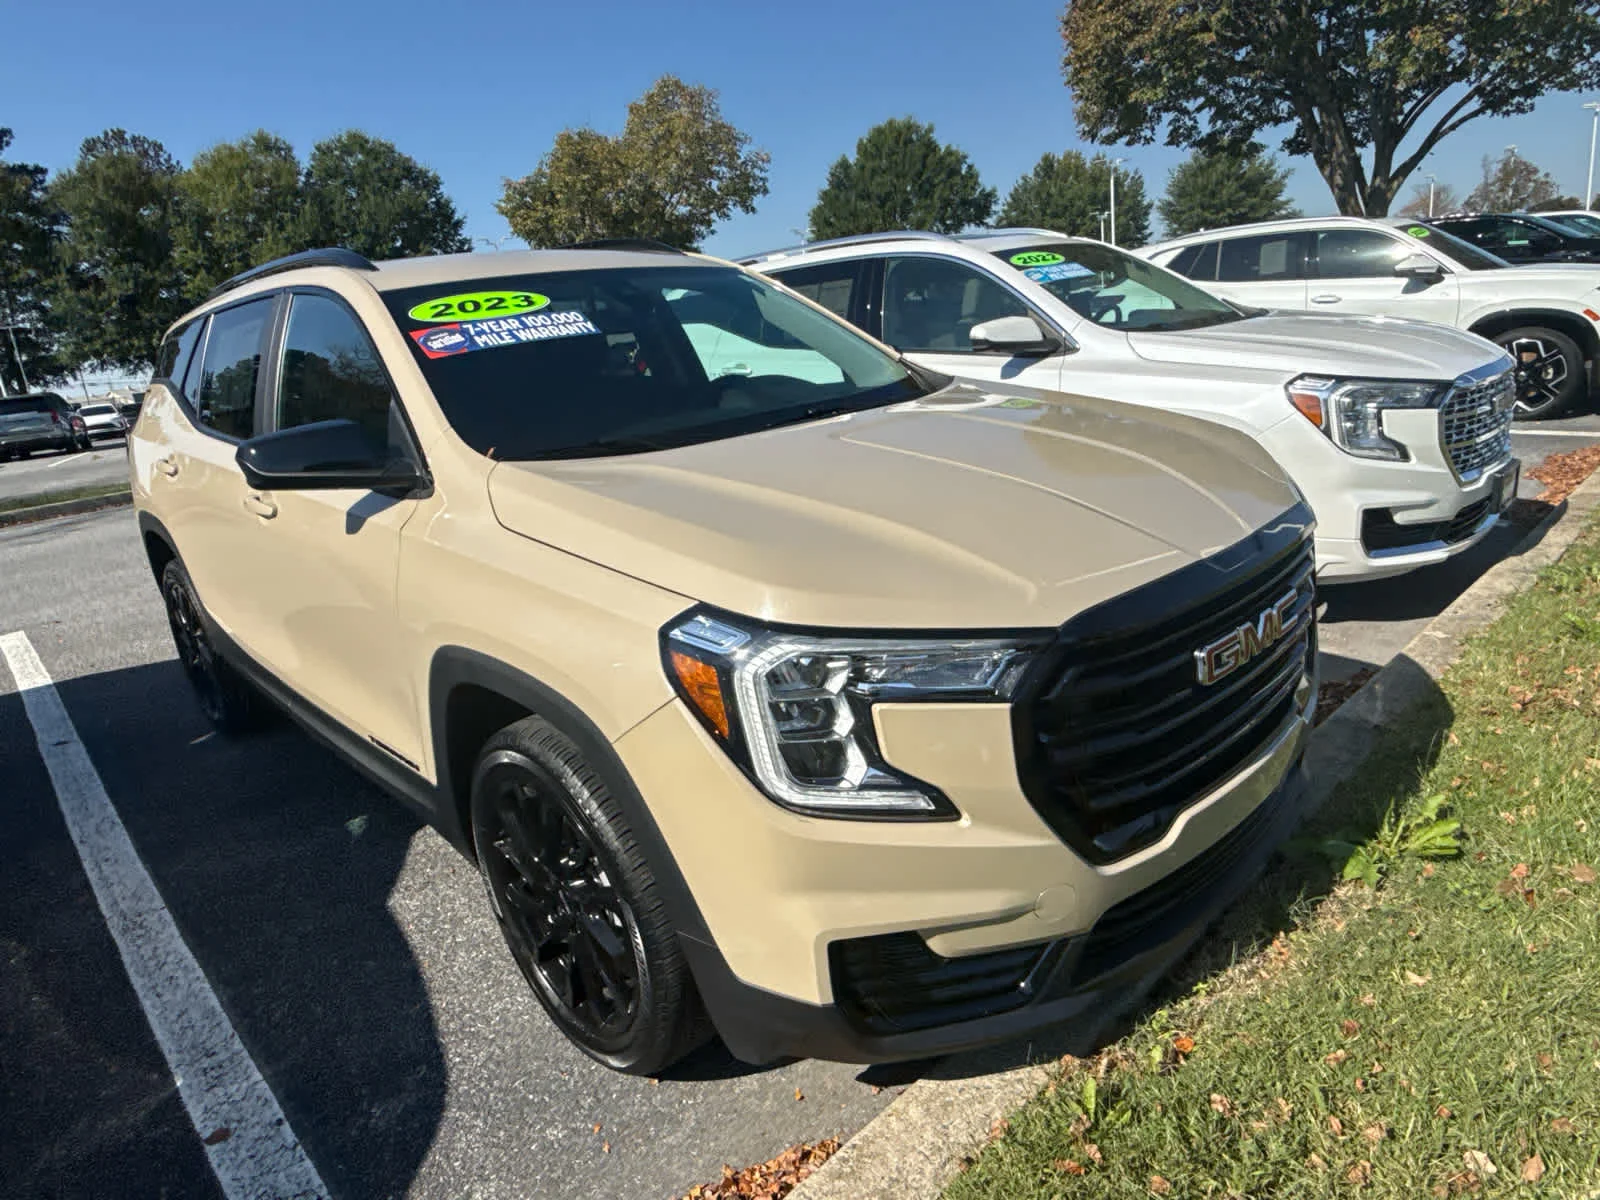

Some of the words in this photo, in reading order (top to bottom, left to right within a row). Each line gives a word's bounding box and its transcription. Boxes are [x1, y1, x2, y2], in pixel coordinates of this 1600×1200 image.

[1017, 253, 1060, 264] 2022
[430, 295, 536, 318] 2023
[463, 318, 521, 336] 7-YEAR
[523, 311, 584, 328] 100,000
[473, 331, 516, 347] MILE
[514, 321, 596, 342] WARRANTY
[1194, 588, 1299, 686] GMC
